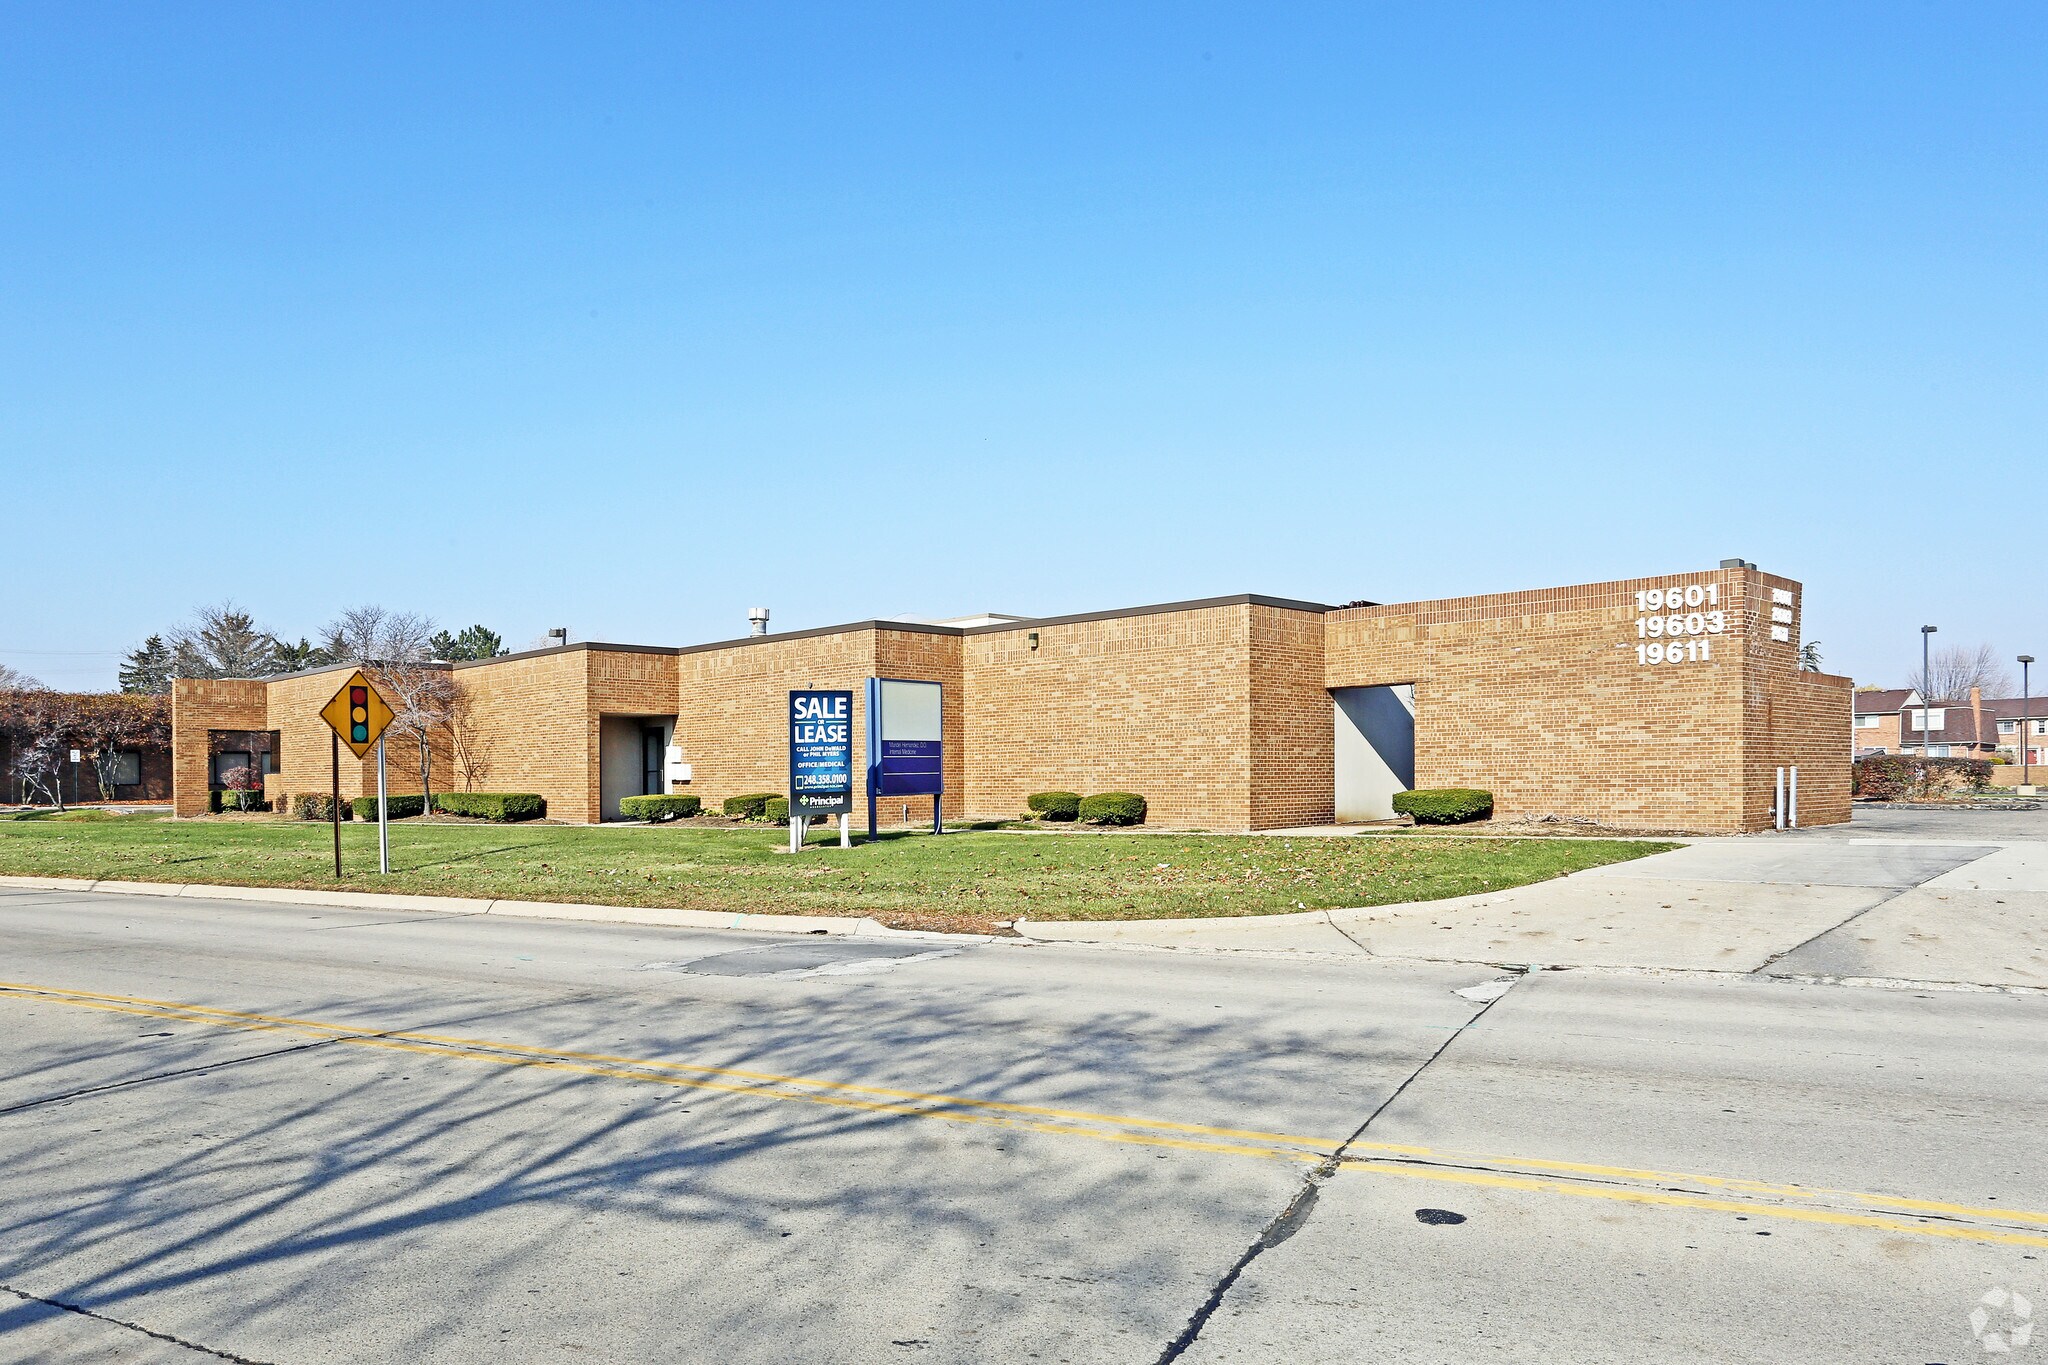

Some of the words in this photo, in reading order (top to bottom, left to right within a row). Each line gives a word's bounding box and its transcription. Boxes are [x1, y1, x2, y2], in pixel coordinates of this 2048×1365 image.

[1634, 583, 1718, 612] 19601
[1634, 610, 1725, 639] 19603
[1634, 639, 1710, 665] 19611
[794, 697, 848, 719] SALE
[794, 725, 848, 744] LEASE
[803, 773, 848, 785] 248.358.0100
[809, 795, 844, 807] Principal
